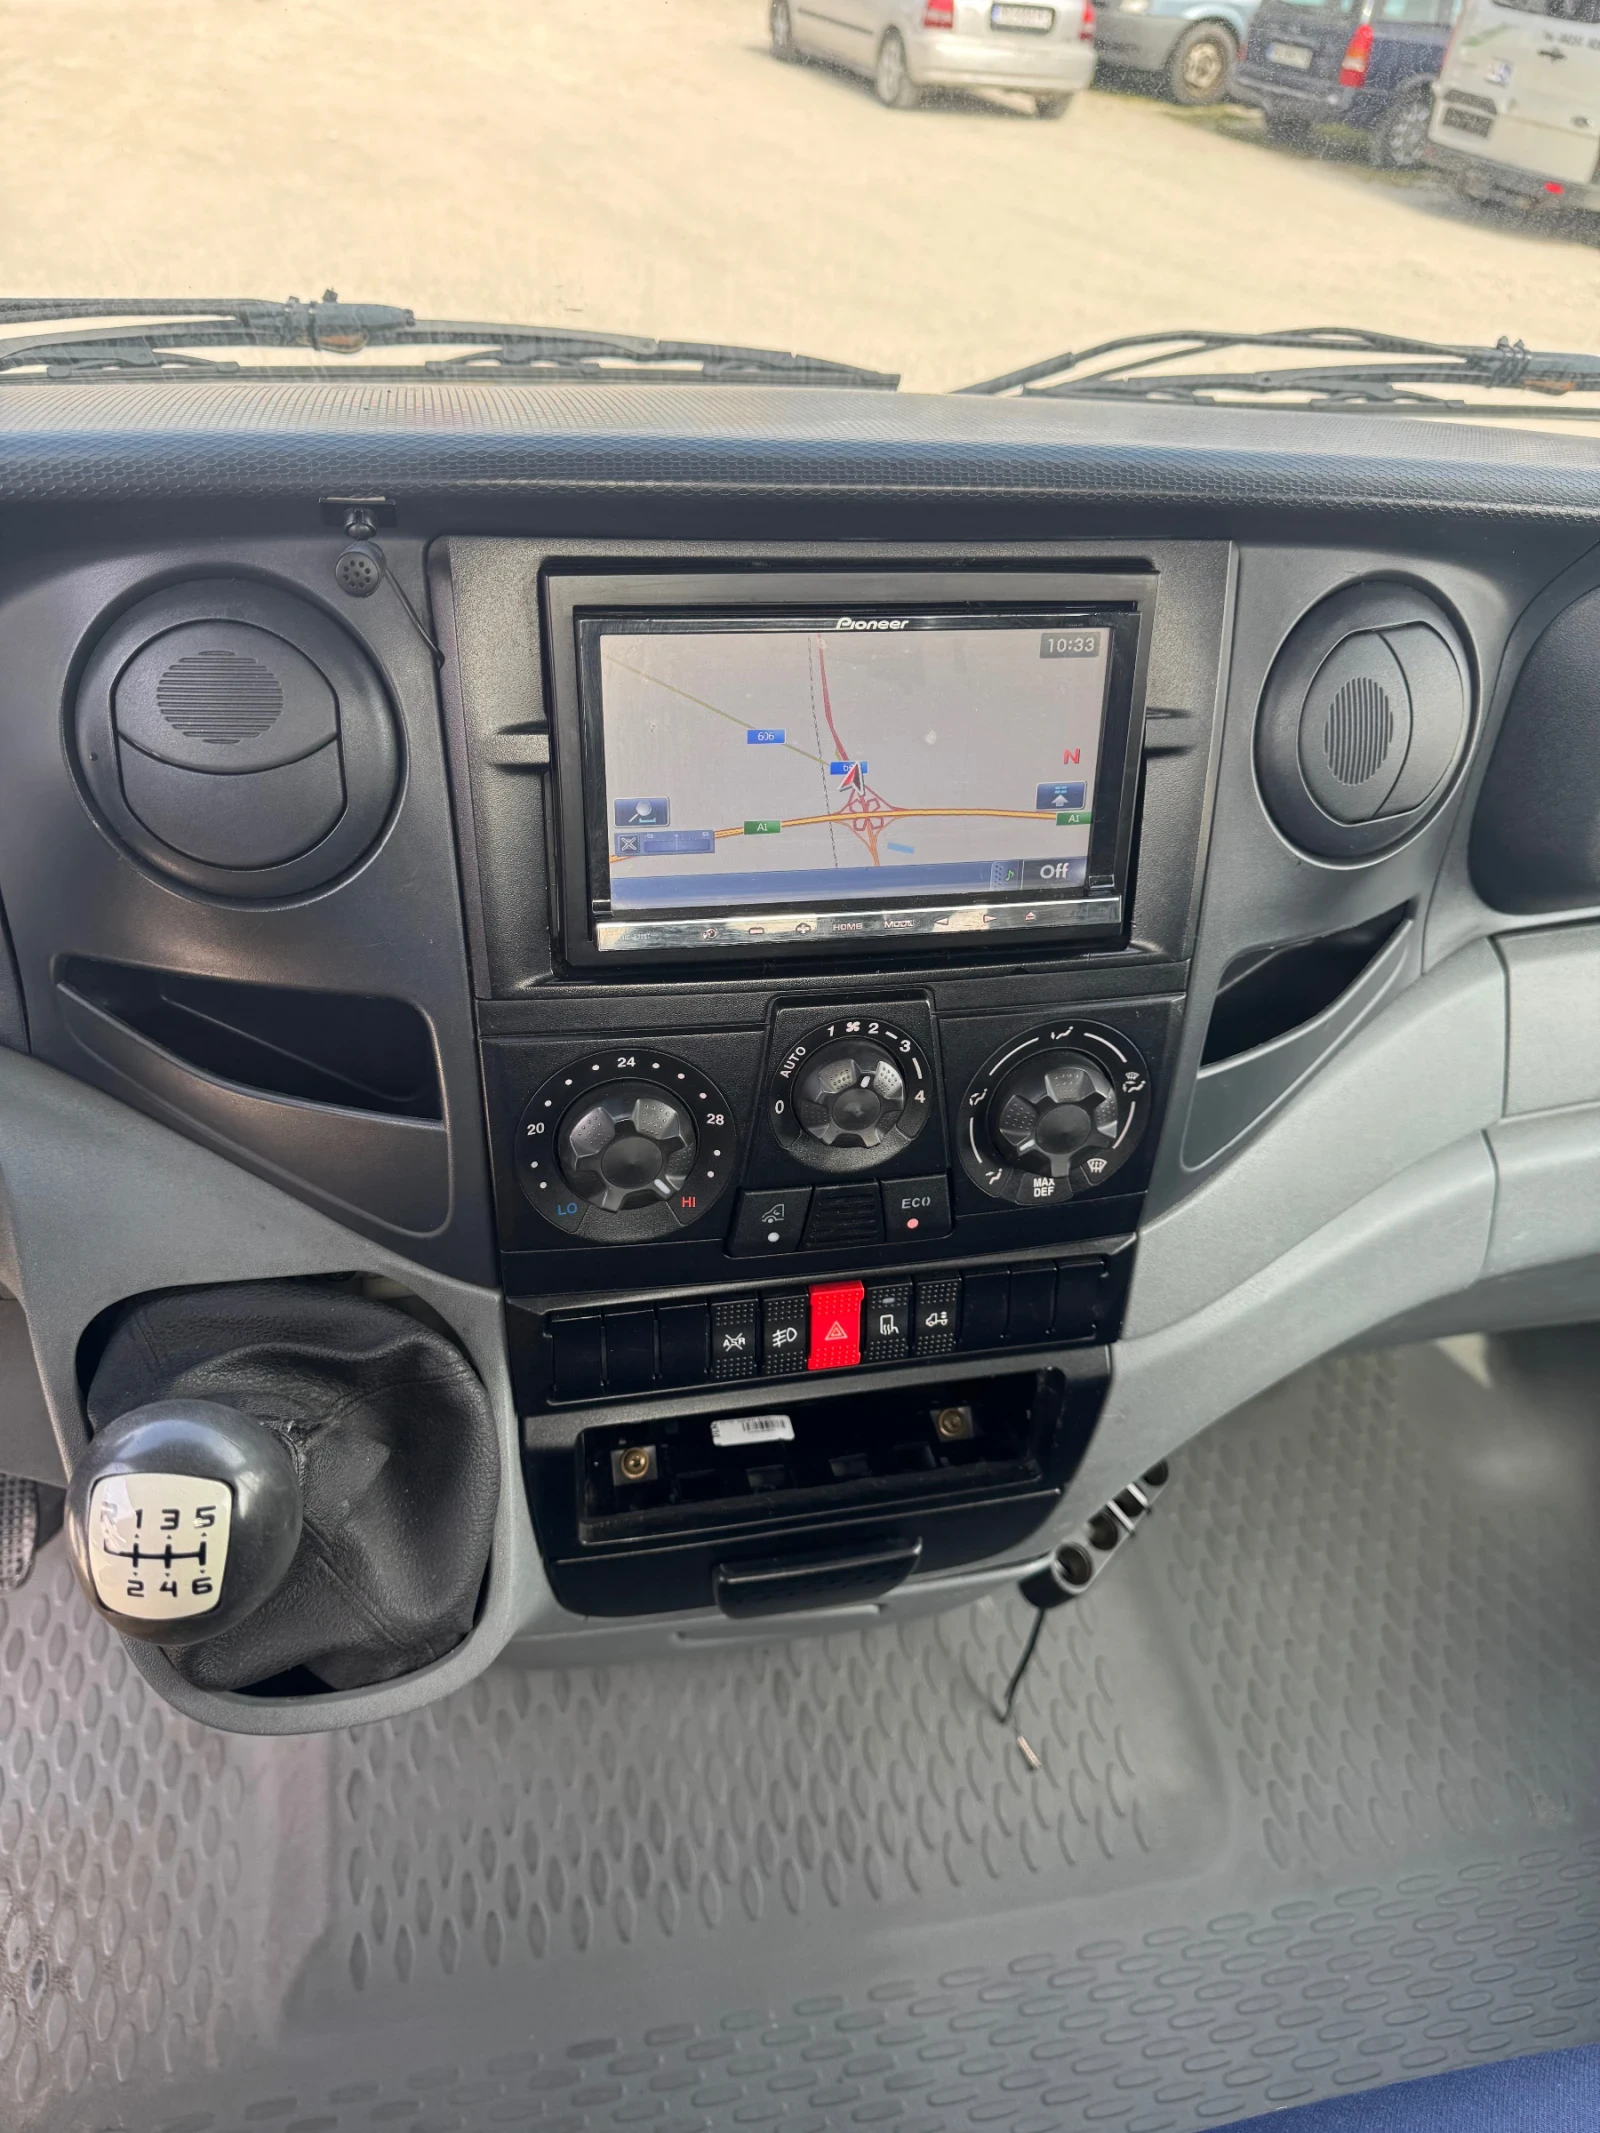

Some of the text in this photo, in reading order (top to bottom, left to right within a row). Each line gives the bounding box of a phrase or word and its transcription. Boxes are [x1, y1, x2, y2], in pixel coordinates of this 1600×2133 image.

[836, 617, 909, 630] Pioneer
[1048, 637, 1095, 653] 10:33
[757, 731, 775, 741] 606
[1063, 748, 1080, 765] N
[1068, 814, 1080, 823] A1
[756, 822, 768, 832] A1
[1039, 862, 1070, 879] Off
[833, 922, 863, 931] HOME
[827, 1025, 835, 1037] 1
[868, 1022, 879, 1034] 2
[899, 1039, 911, 1052] 3
[617, 1056, 637, 1068] 24
[779, 1046, 806, 1079] AUTO
[914, 1089, 926, 1104] 4
[706, 1113, 725, 1126] 28
[527, 1122, 545, 1136] 20
[1033, 1177, 1056, 1188] MAX
[1033, 1186, 1055, 1198] DEF
[681, 1196, 696, 1208] HI
[901, 1196, 931, 1209] ECO
[557, 1202, 578, 1216] LO
[723, 1337, 746, 1348] ASR
[135, 1508, 143, 1529] 1
[160, 1509, 180, 1530] 3
[196, 1505, 216, 1528] 5
[127, 1577, 213, 1598] 2 4 6
